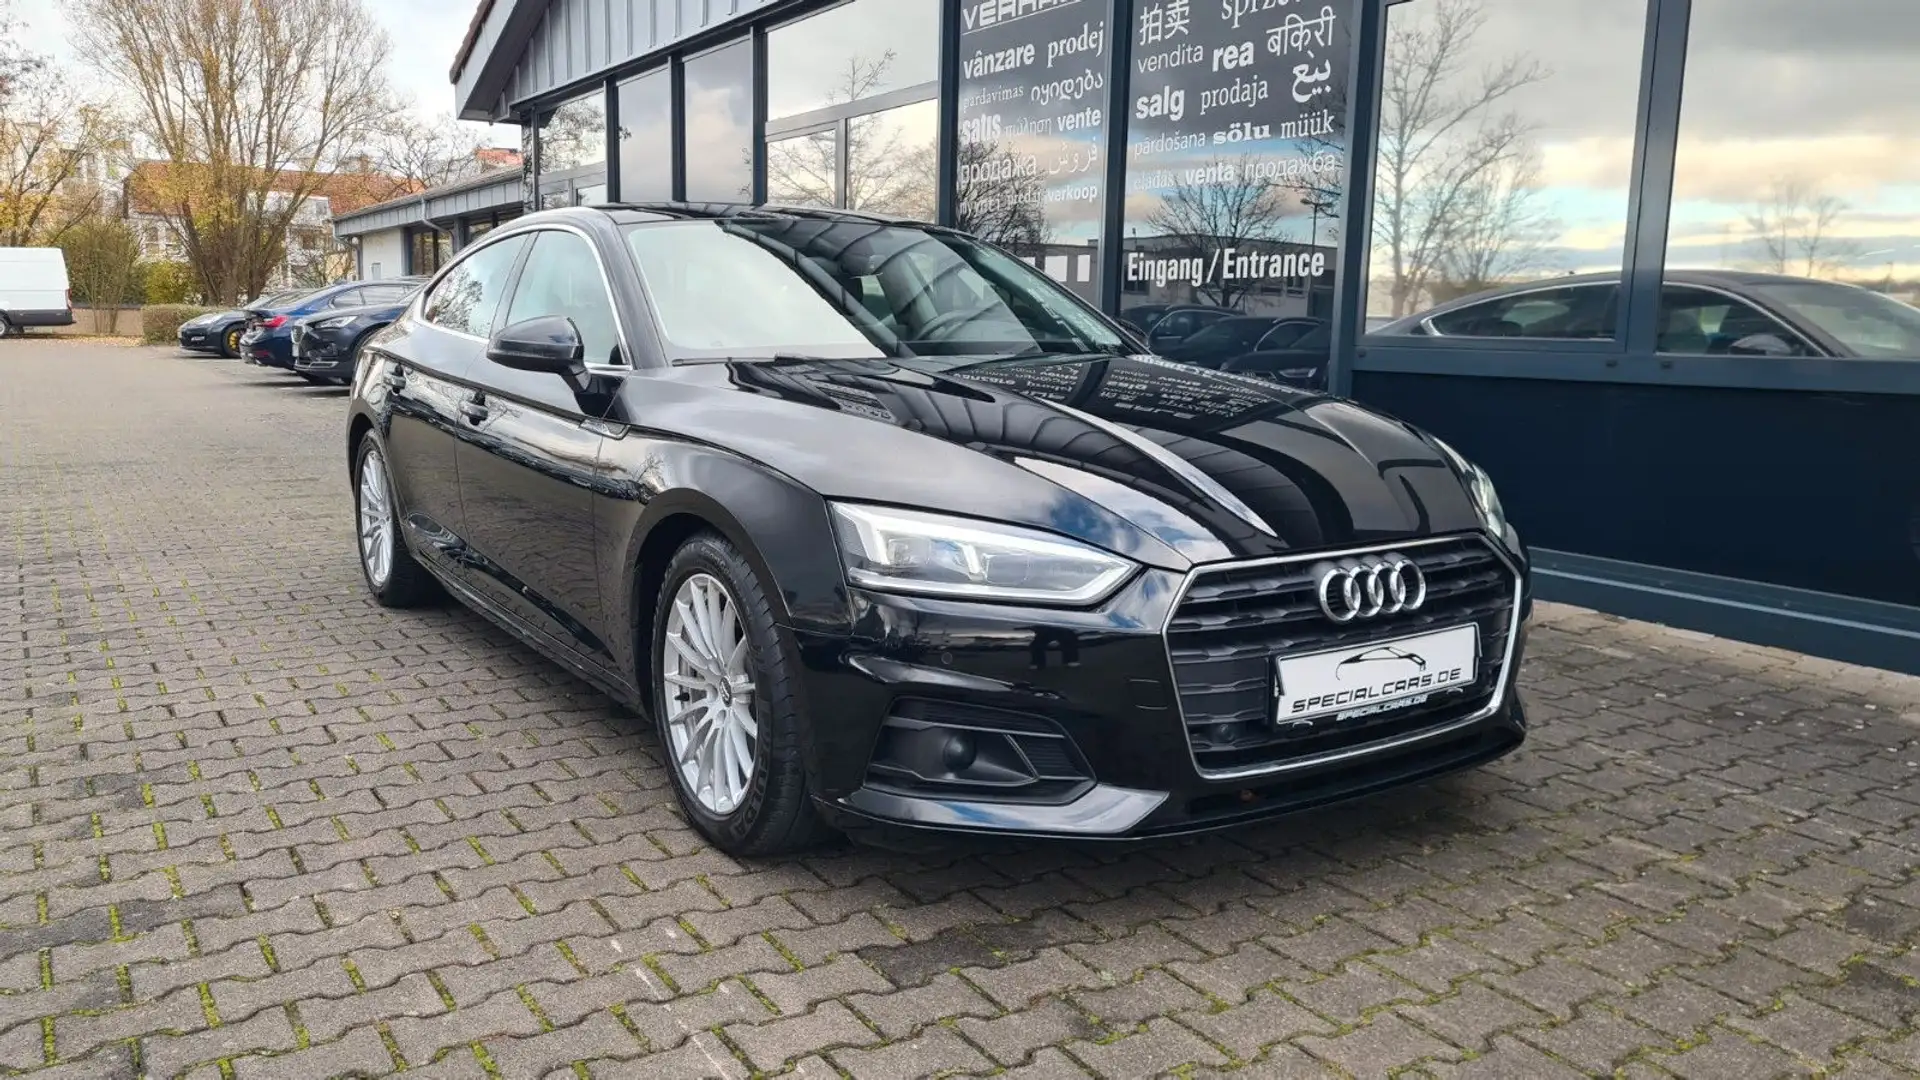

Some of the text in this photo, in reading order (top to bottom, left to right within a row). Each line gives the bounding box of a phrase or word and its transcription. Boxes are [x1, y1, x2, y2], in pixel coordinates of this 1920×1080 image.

[1139, 0, 1190, 46] 拍卖
[963, 21, 1104, 79] vânzare prodej
[1137, 41, 1255, 74] vendita rea
[963, 84, 1024, 112] pardavimas
[1135, 74, 1269, 121] salg prodaja
[1291, 59, 1332, 103] بيع
[1057, 106, 1102, 131] vente
[1212, 122, 1271, 145] sölu
[1280, 108, 1335, 139] müük
[1185, 163, 1235, 186] venta
[1244, 149, 1336, 184] продажба
[1047, 184, 1098, 203] verkoop
[1291, 667, 1462, 713] SPECIALCARS.DE
